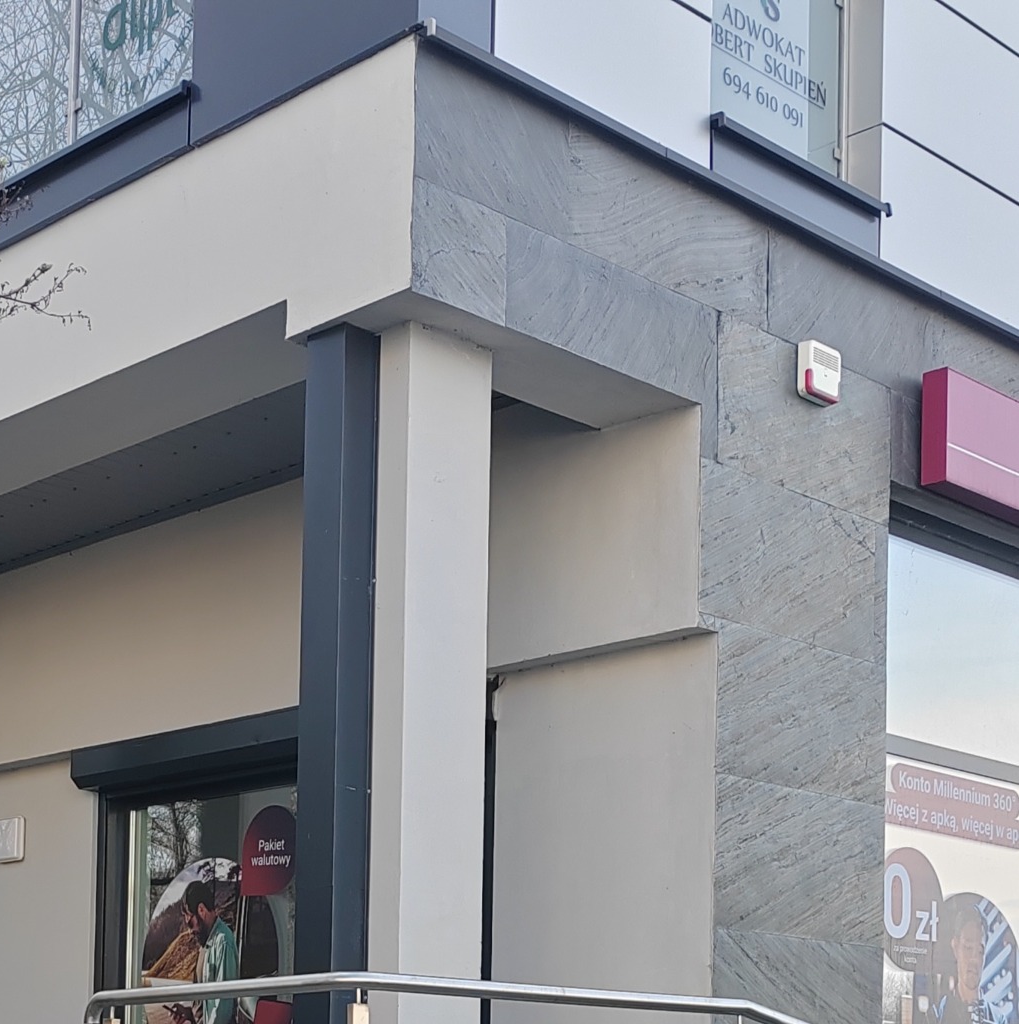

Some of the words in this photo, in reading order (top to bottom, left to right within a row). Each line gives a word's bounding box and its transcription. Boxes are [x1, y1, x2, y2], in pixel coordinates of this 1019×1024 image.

[722, 3, 805, 66] ADWOKAT
[712, 22, 755, 62] BERT
[764, 53, 826, 107] SKUPIEŃ
[723, 67, 751, 100] 694
[756, 86, 778, 112] 610
[783, 103, 803, 128] 091
[899, 770, 931, 793] Konto
[933, 779, 991, 807] Millennium
[993, 793, 1016, 812] 360°
[258, 839, 285, 851] Pakiet
[922, 809, 928, 823] z
[931, 809, 958, 832] apką,
[962, 816, 994, 840] więcej
[996, 824, 1004, 838] w
[251, 854, 291, 868] walutowy
[884, 863, 911, 939] 0
[915, 901, 939, 942] zł
